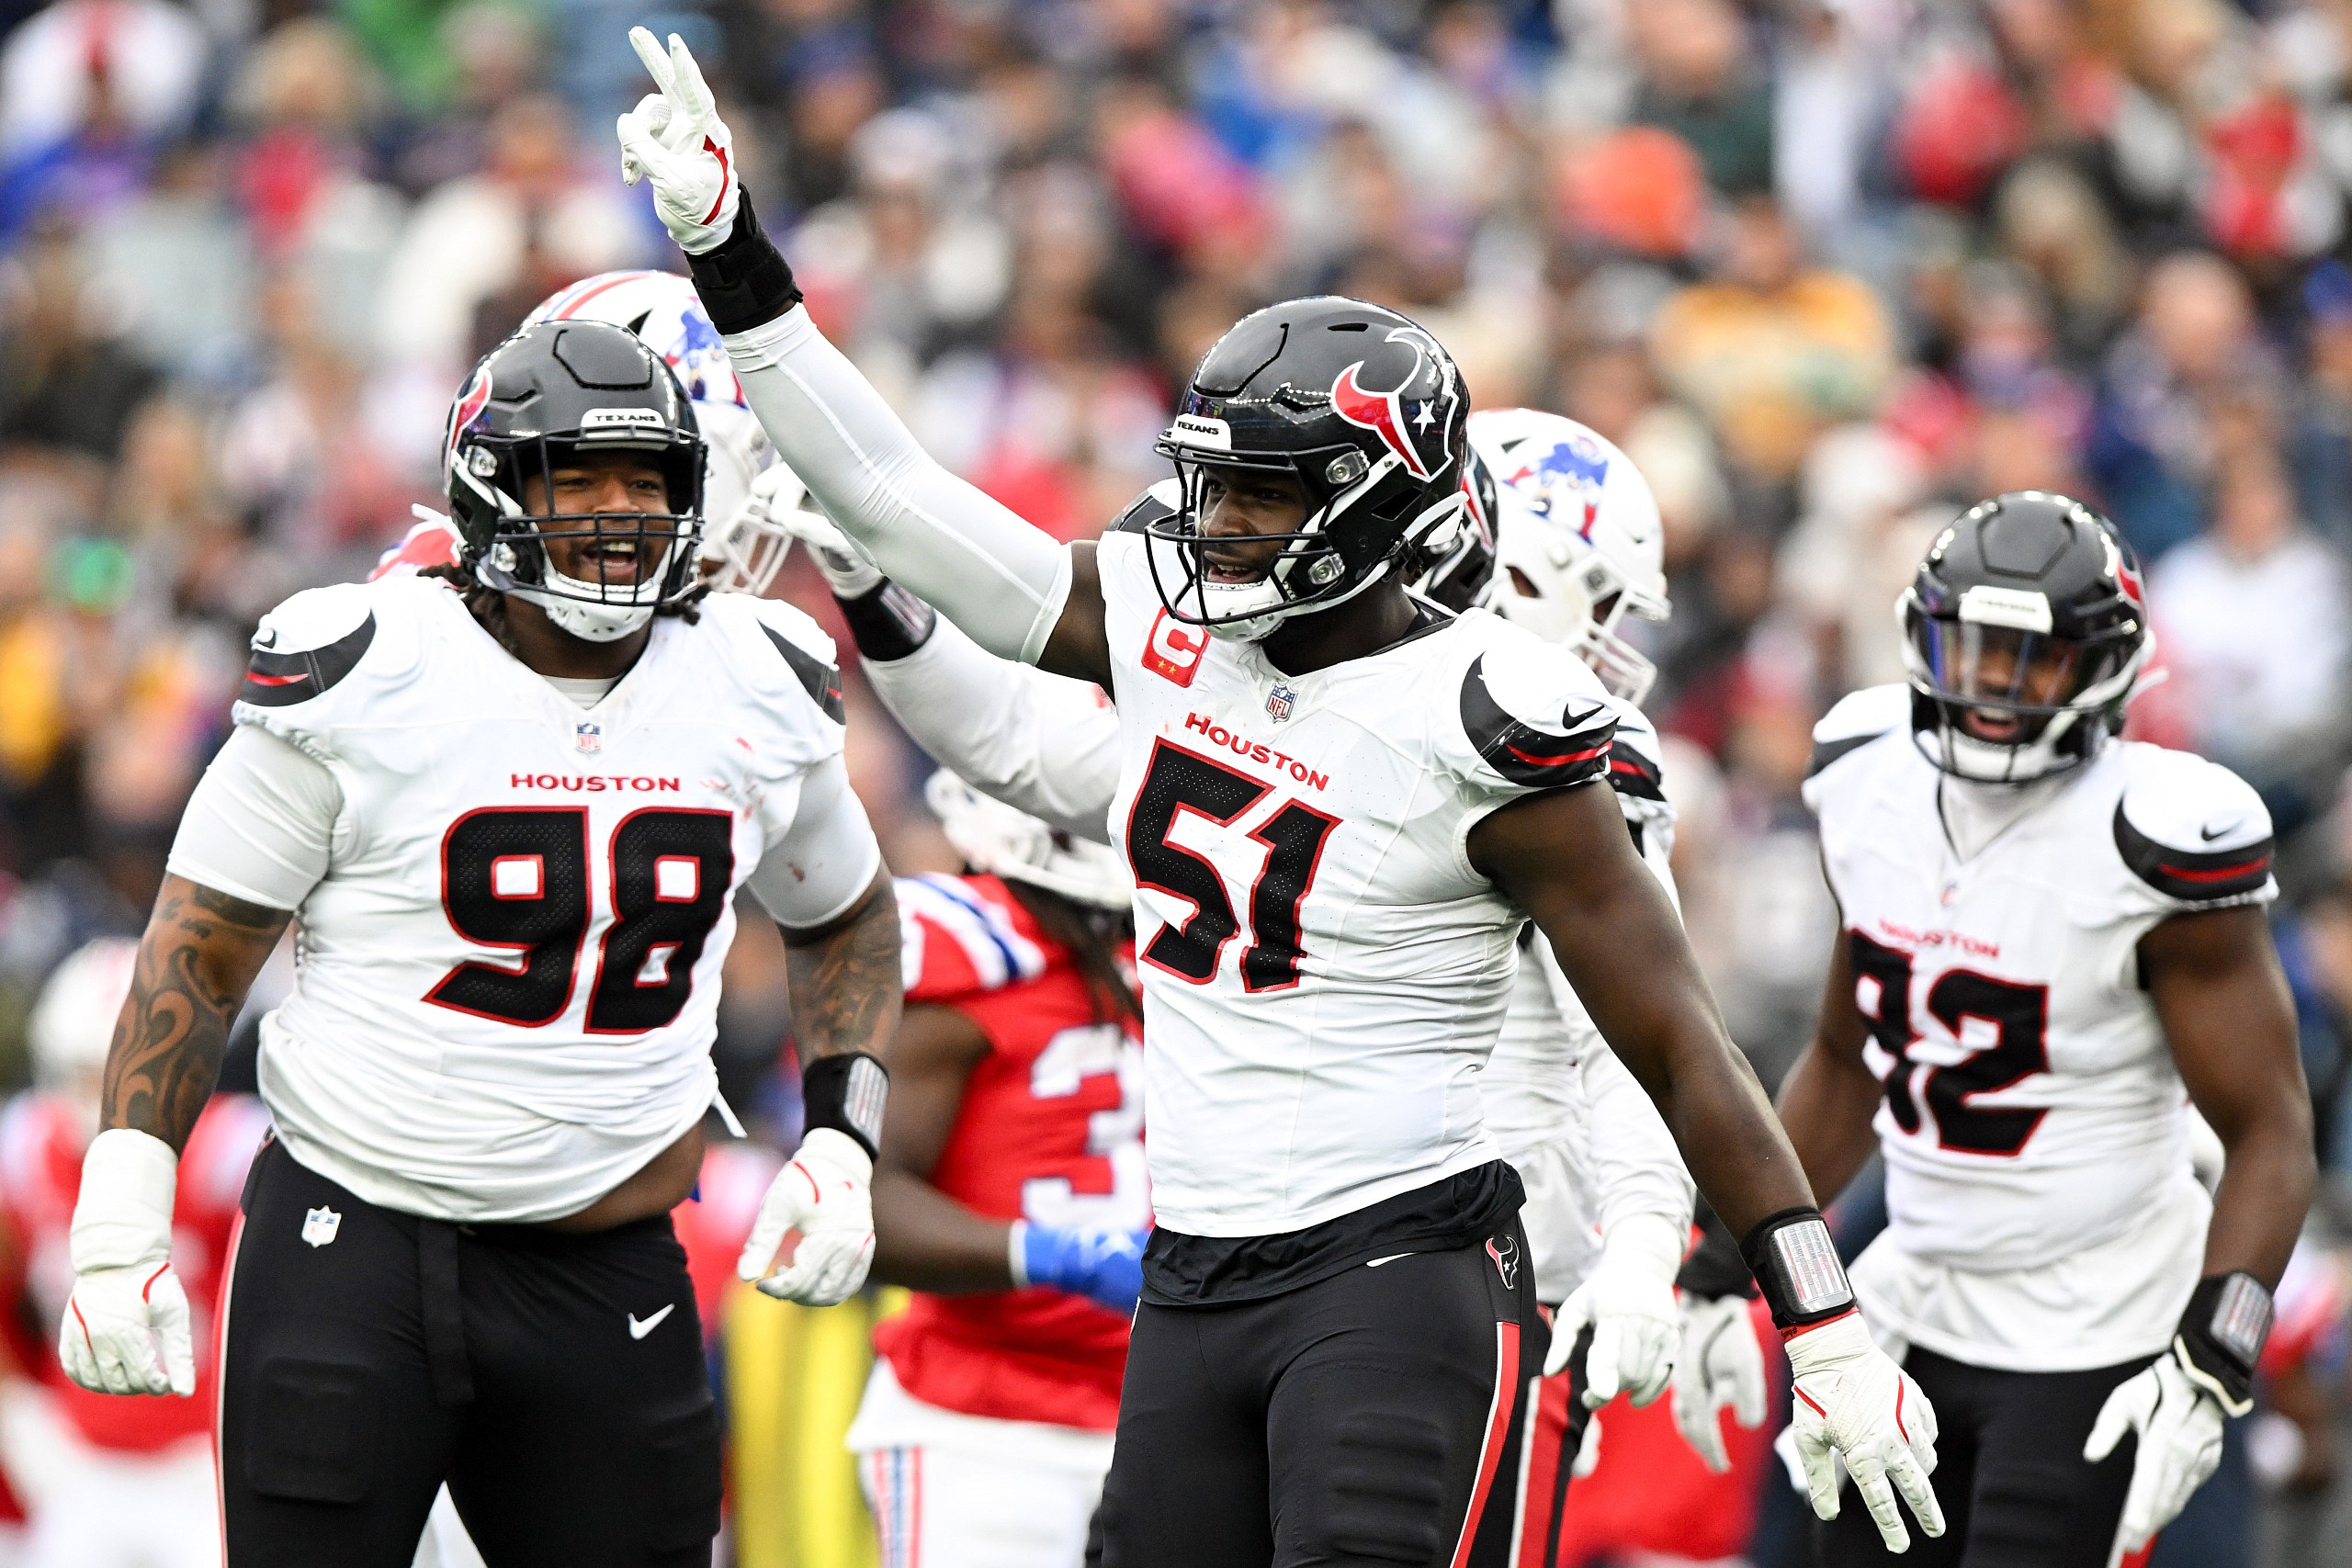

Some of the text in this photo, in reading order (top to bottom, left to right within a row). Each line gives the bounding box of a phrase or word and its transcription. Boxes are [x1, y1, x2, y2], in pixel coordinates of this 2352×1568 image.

[594, 414, 658, 423] TEXANS
[1177, 421, 1220, 435] TEXANS
[1152, 613, 1205, 668] C
[1268, 696, 1288, 716] NFL
[1184, 712, 1329, 792] HOUSTON
[511, 773, 680, 792] HOUSTON
[1125, 734, 1344, 993] 51
[420, 805, 734, 1034] 98
